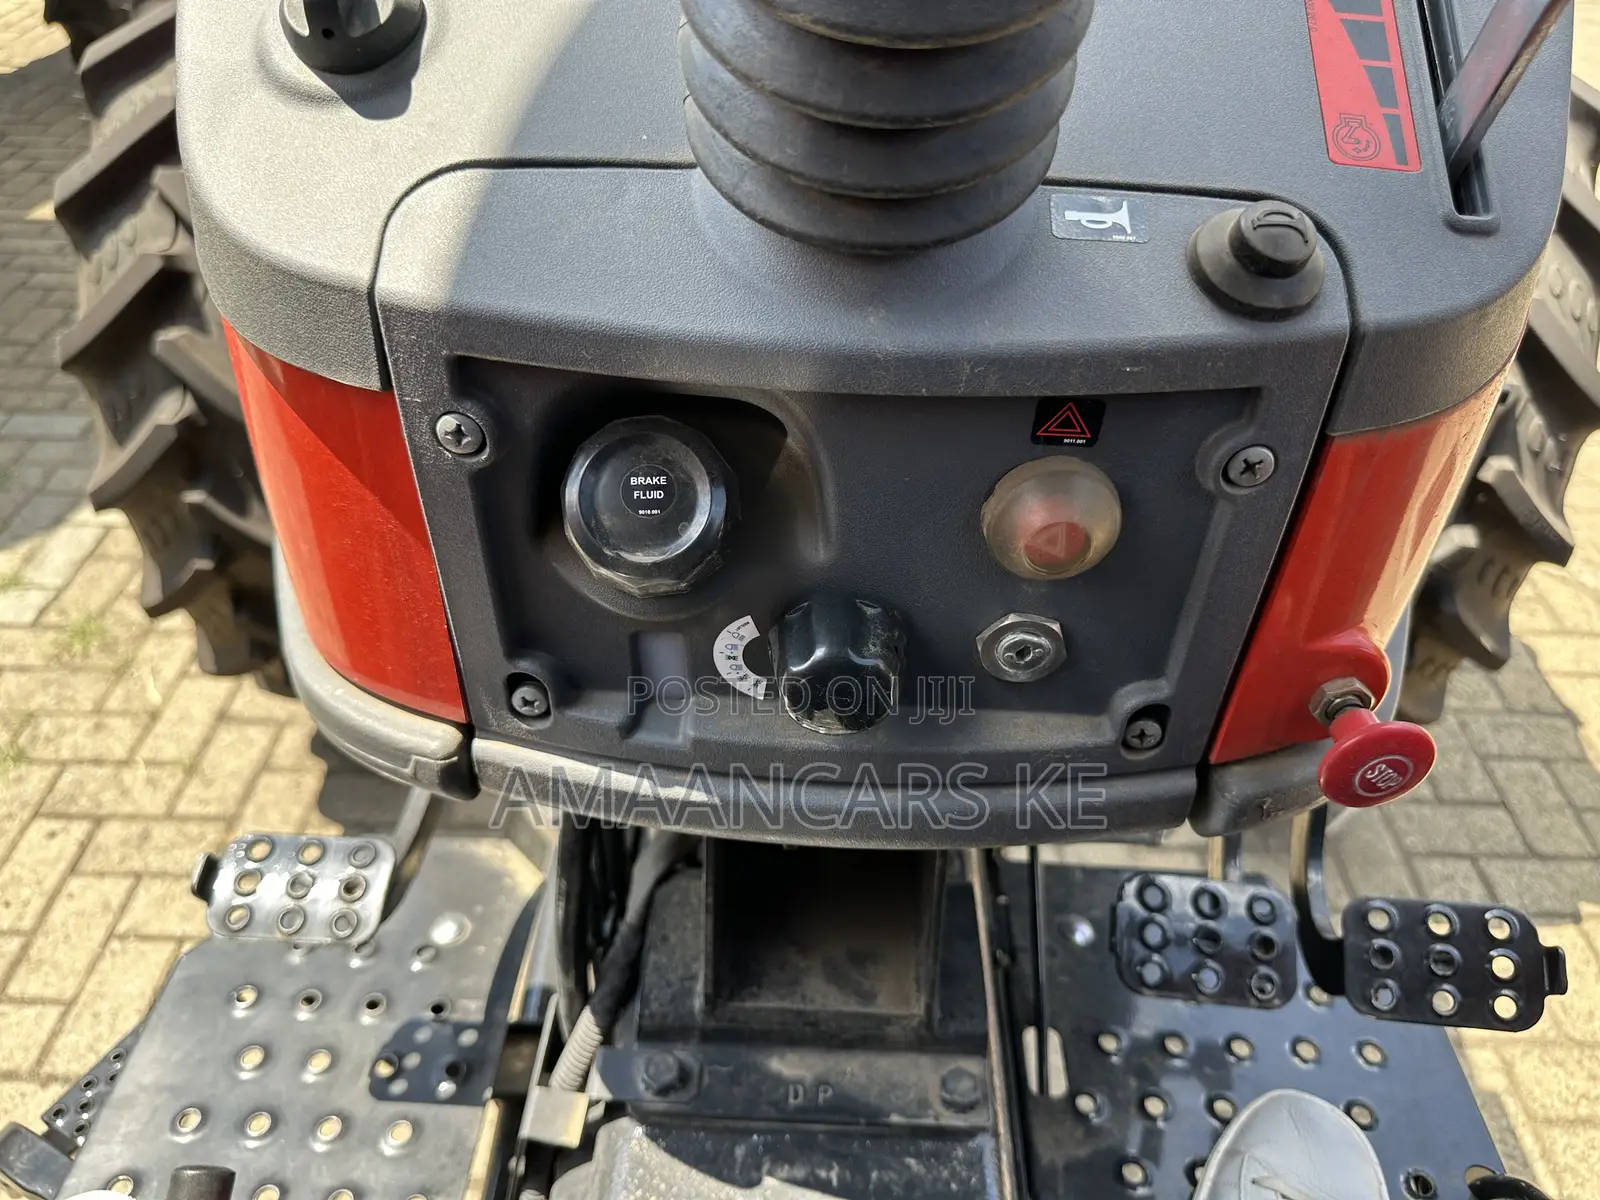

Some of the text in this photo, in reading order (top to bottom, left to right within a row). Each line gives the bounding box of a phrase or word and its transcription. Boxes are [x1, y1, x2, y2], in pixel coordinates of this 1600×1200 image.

[630, 476, 667, 485] BRAKE
[633, 490, 664, 499] FLUID
[1364, 763, 1403, 789] STOP
